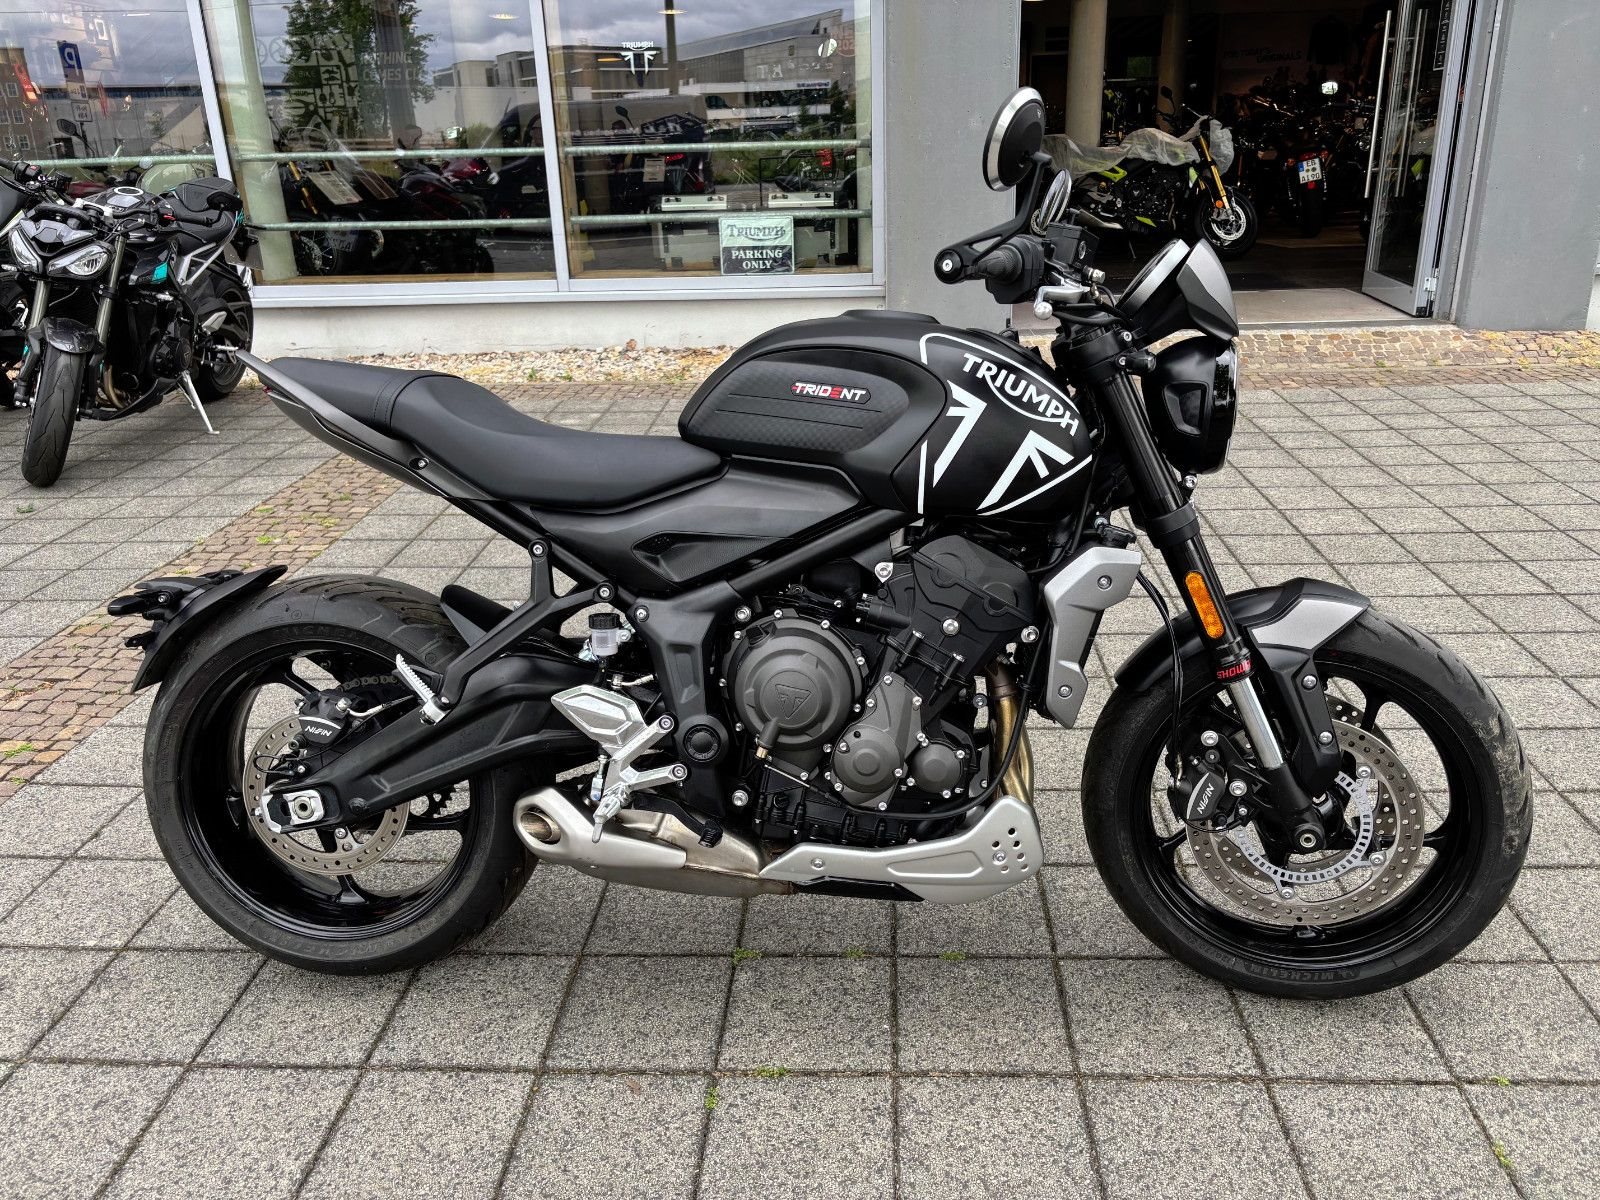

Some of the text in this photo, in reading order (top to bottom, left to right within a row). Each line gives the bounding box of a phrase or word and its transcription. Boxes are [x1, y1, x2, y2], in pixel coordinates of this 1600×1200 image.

[621, 41, 654, 50] TRIUMPH
[727, 224, 786, 242] TRIUMPH
[731, 249, 783, 259] PARKING
[742, 260, 773, 269] ONLY
[791, 382, 867, 401] TRIDENT
[962, 352, 1079, 437] TRIUMPH
